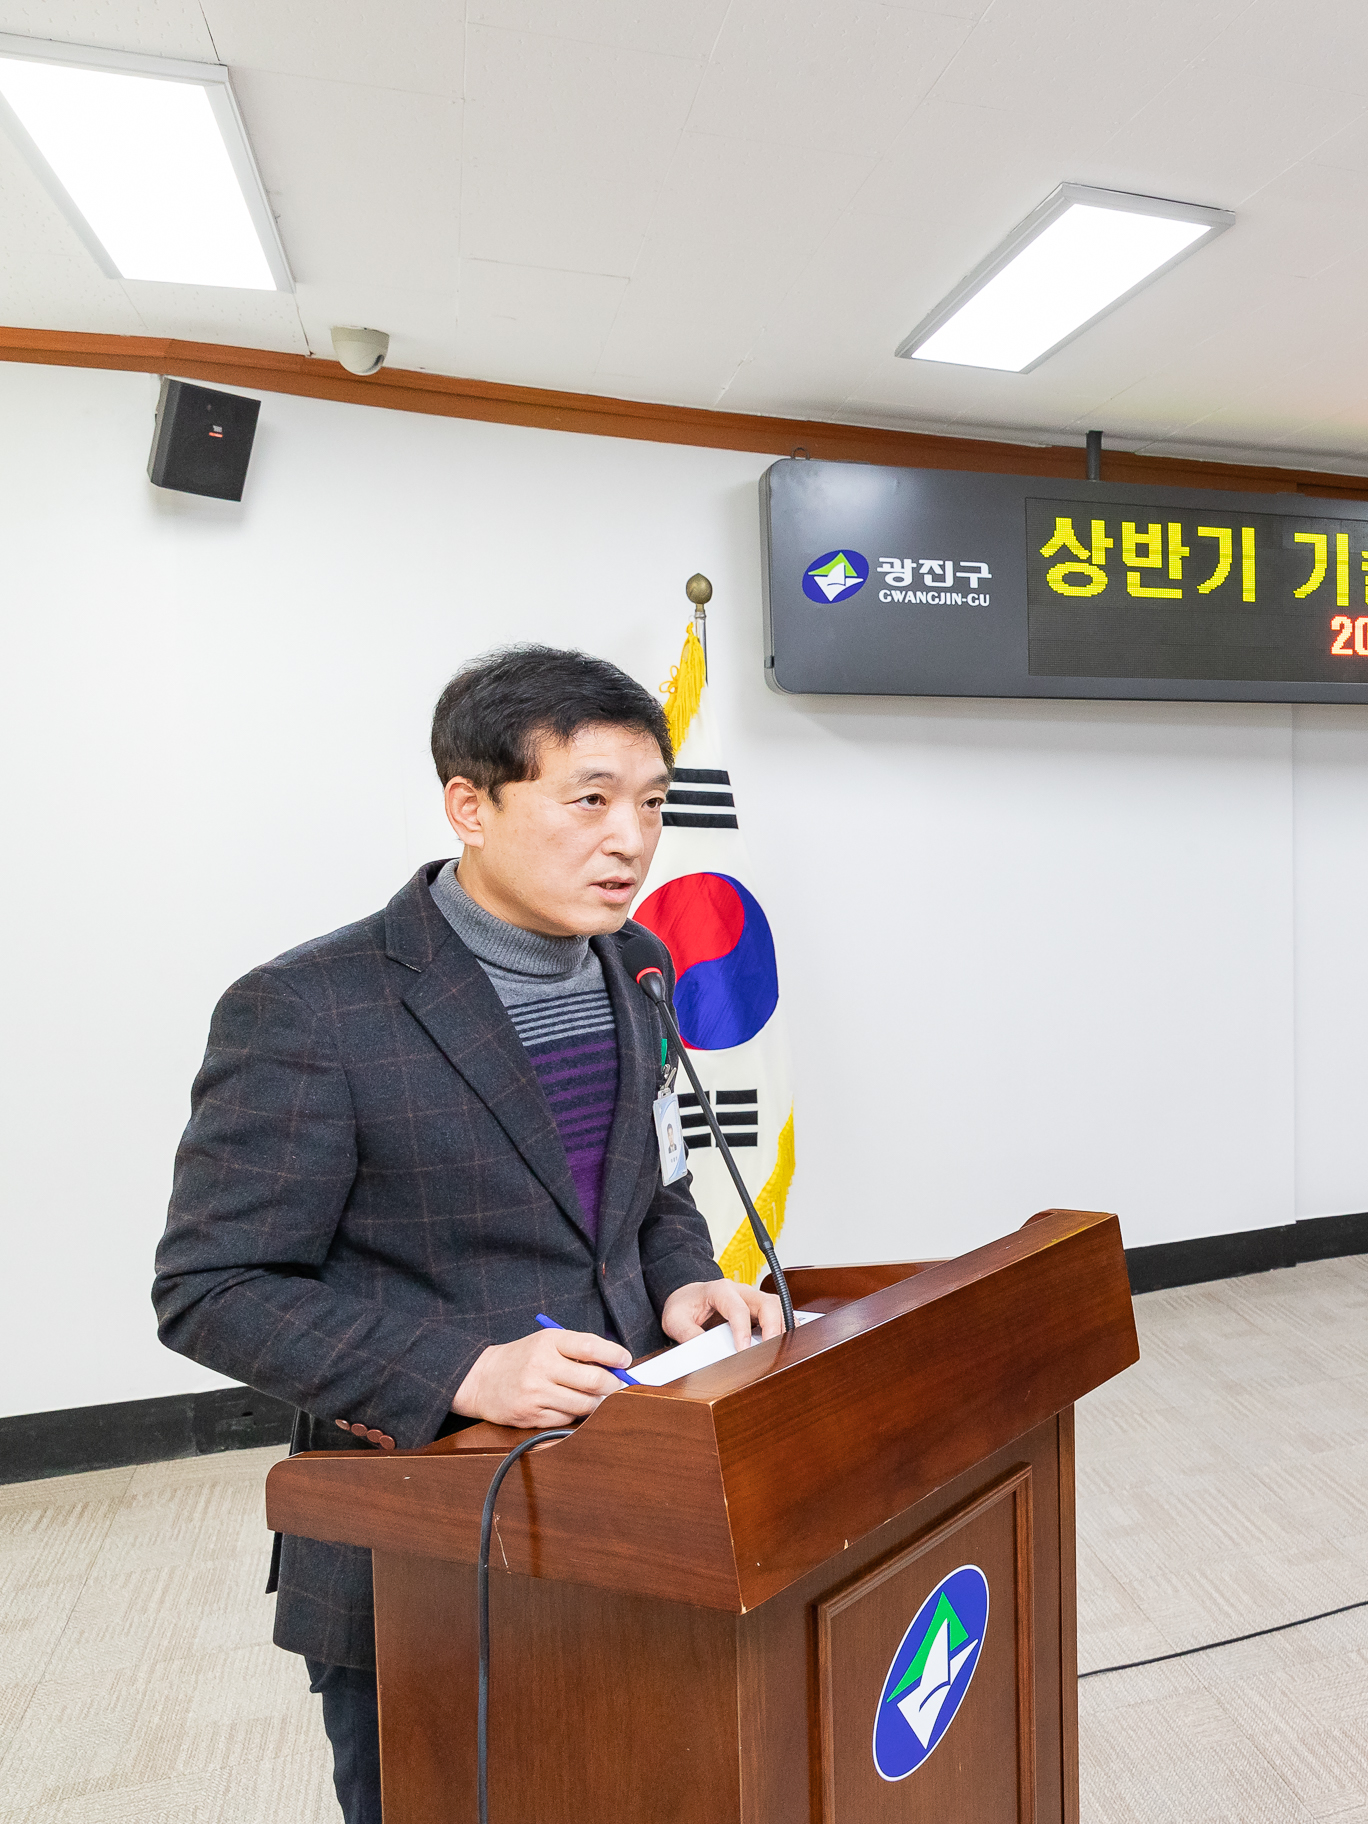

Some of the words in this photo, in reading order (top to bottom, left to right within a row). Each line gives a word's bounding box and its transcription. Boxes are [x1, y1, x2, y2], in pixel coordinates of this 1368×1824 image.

[876, 557, 992, 588] 광진구
[1040, 517, 1255, 603] 상반기
[878, 590, 990, 607] GWANGJIN-GU
